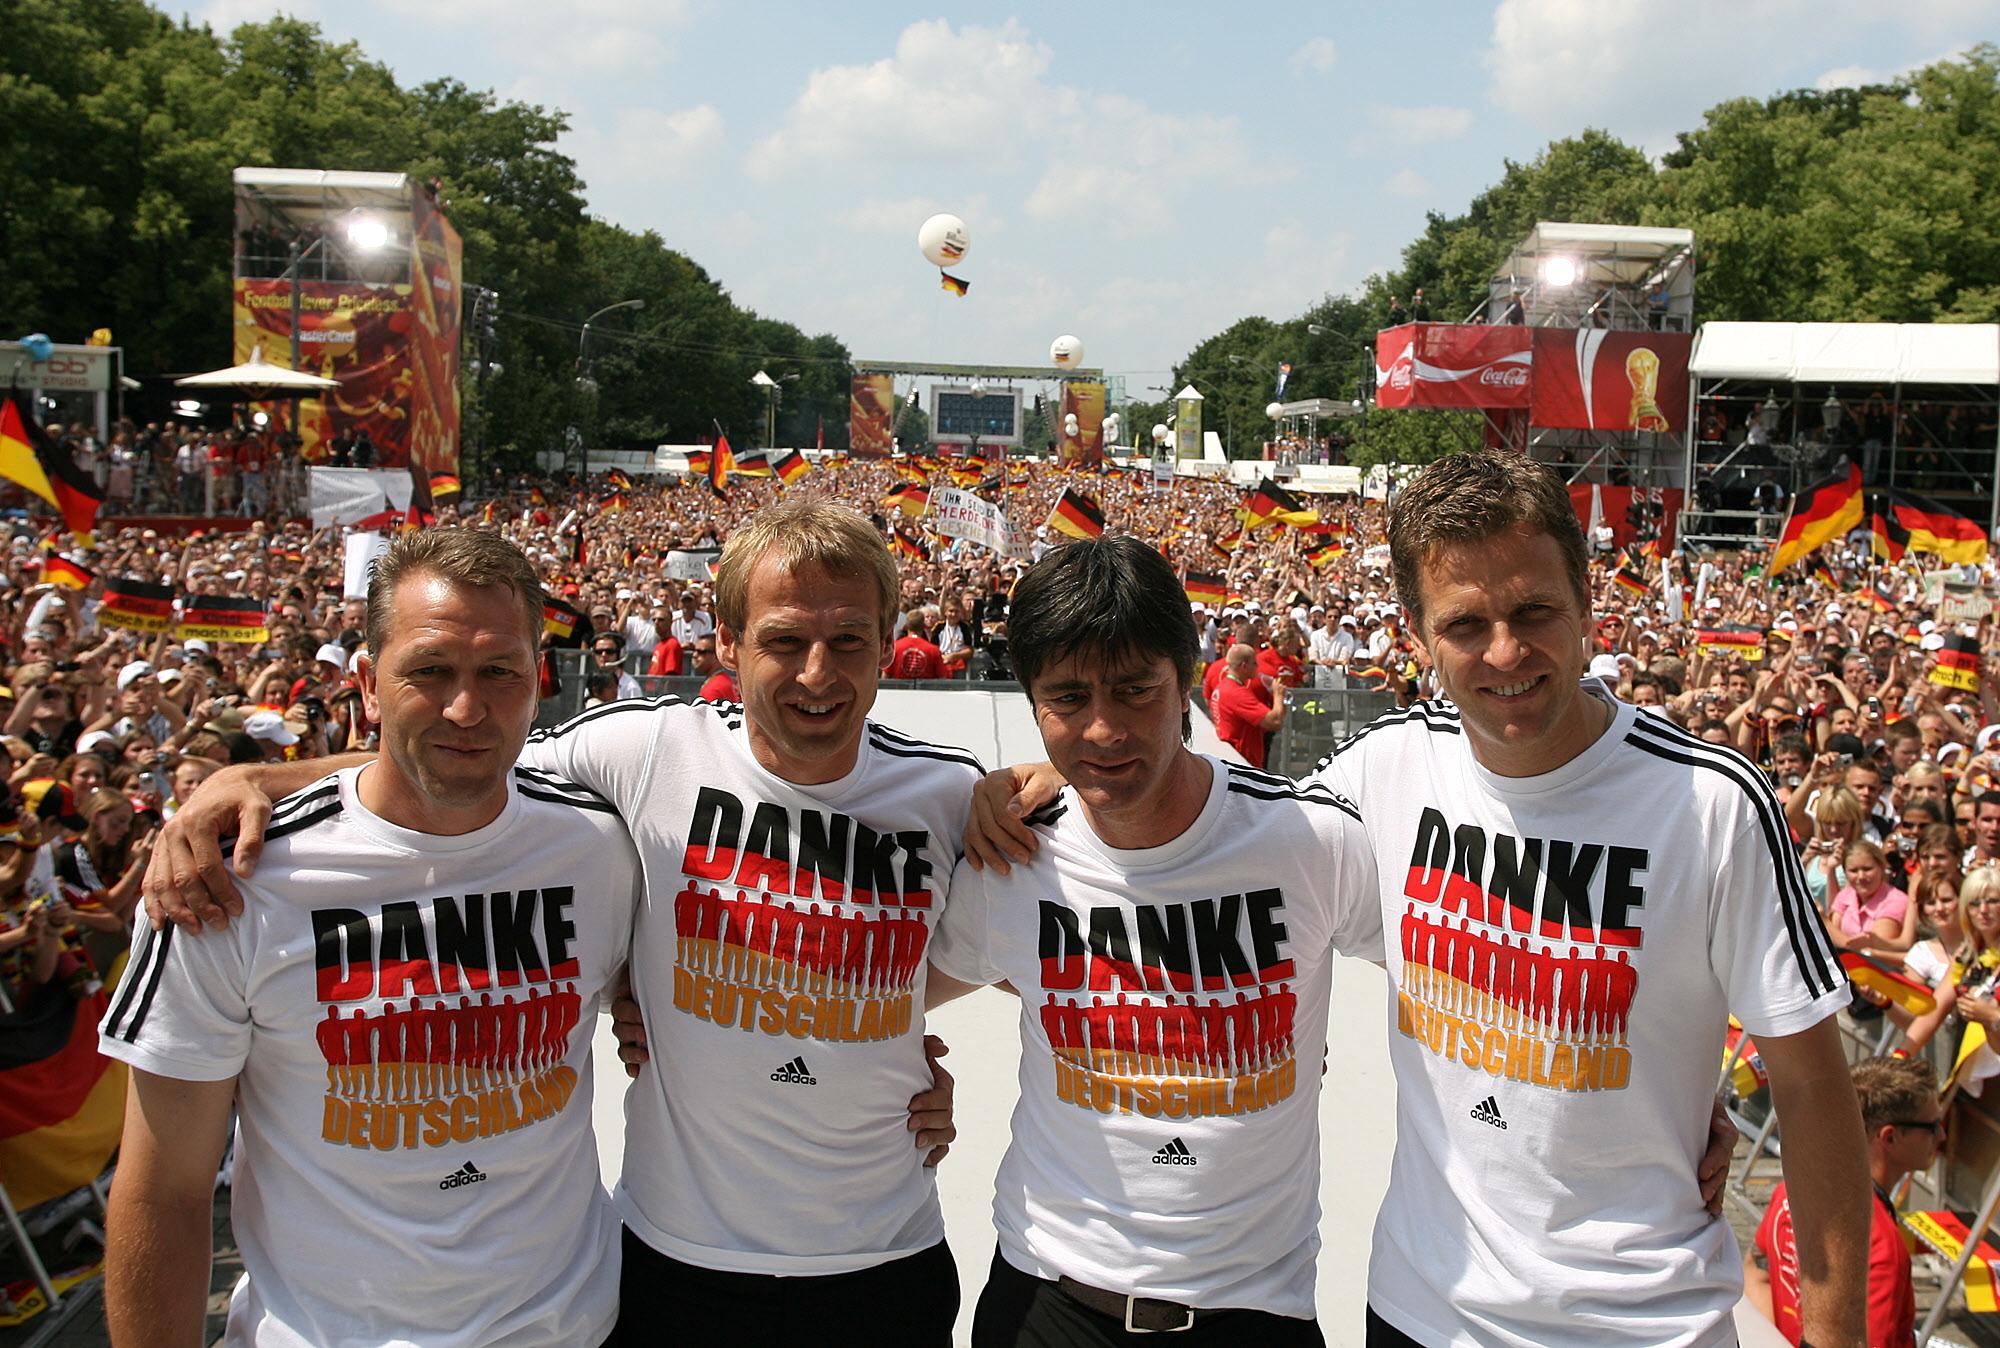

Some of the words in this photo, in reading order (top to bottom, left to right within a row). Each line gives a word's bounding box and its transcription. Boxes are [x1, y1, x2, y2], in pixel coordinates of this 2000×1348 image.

[944, 492, 961, 505] IHR
[184, 626, 229, 639] mach
[681, 786, 932, 909] DANKE
[1403, 807, 1649, 948] DANKE
[311, 886, 580, 1003] DANKE
[1038, 888, 1296, 993] DANKE
[672, 964, 913, 1043] DEUTSCHLAND
[1398, 989, 1633, 1092] DEUTSCHLAND
[321, 1065, 579, 1151] DEUTSCHLAND
[770, 1071, 817, 1086] adidas
[1056, 1056, 1297, 1119] DEUTSCHLAND
[1470, 1107, 1508, 1131] adidas
[439, 1170, 487, 1191] adidas
[1152, 1153, 1198, 1166] adidas
